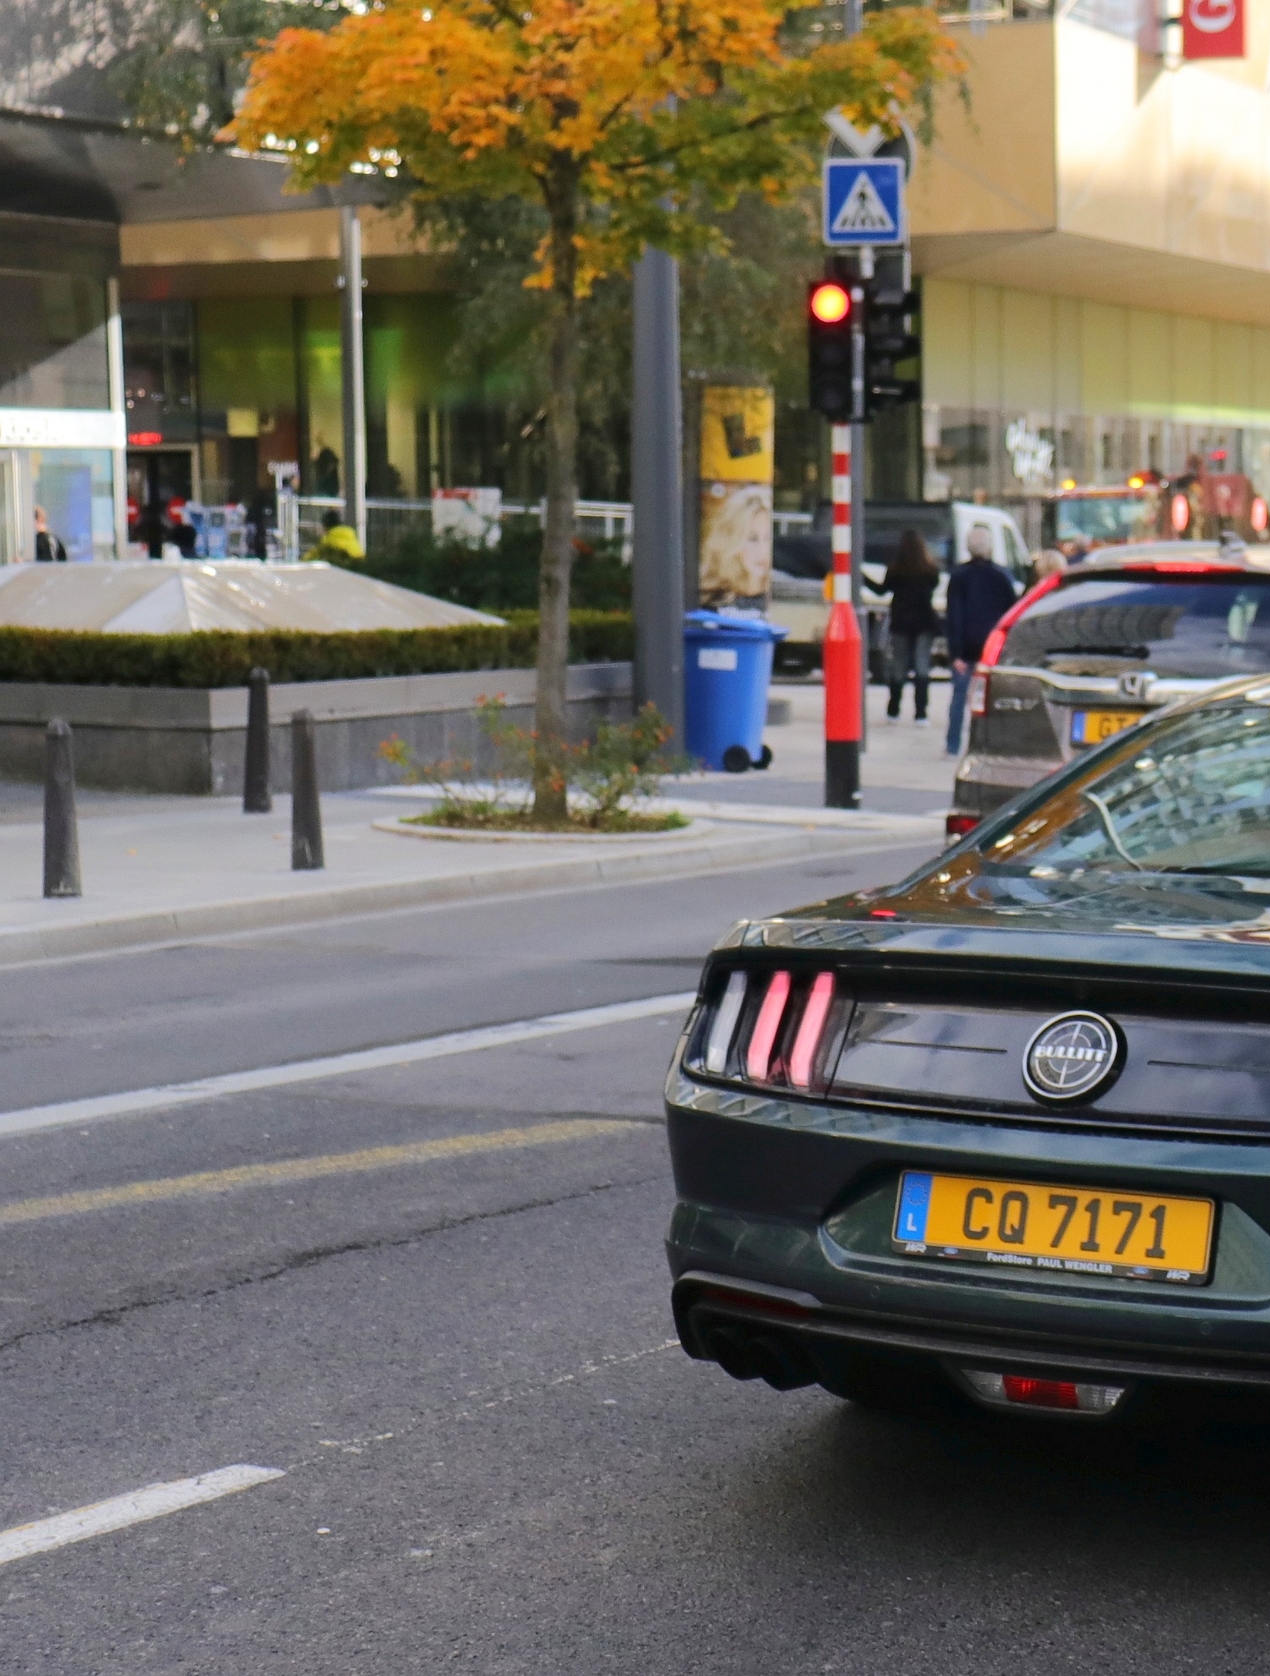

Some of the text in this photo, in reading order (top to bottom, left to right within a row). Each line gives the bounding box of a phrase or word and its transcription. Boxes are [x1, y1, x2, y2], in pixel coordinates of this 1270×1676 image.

[1034, 1045, 1108, 1062] BULLITT
[905, 1212, 918, 1232] L
[962, 1187, 1166, 1259] CQ 7171
[986, 1251, 1113, 1274] FordStore PAUL WENGLER
